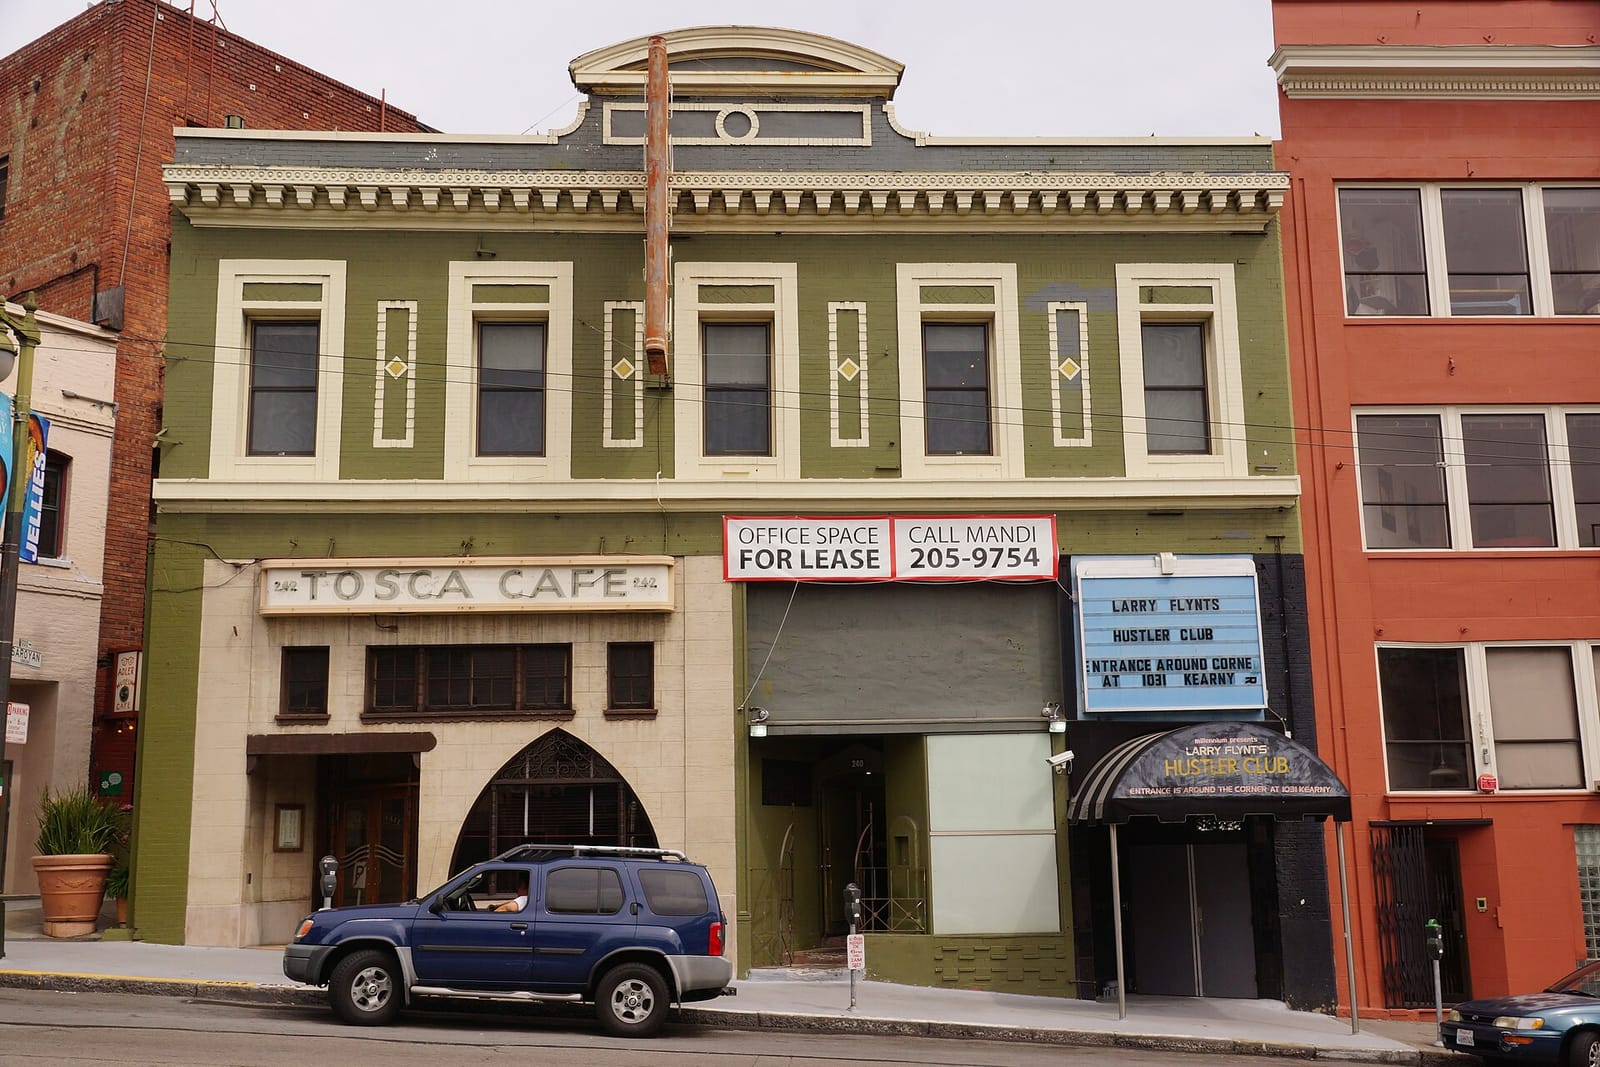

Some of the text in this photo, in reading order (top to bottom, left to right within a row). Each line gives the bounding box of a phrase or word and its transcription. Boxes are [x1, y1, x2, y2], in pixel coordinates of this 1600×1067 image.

[26, 450, 46, 561] JELLIES
[738, 526, 879, 545] OFFICE SPACE
[908, 525, 1037, 544] CALL MANDI
[739, 549, 880, 570] FOR LEASE
[910, 547, 1040, 569] 205-9754
[274, 568, 659, 601] 242 TOSCA CAFE 242
[1112, 598, 1220, 613] LARRY FLYNTS
[1113, 628, 1213, 642] HUSTLER CLUB
[1086, 657, 1252, 673] ENTRANCE AROUND CORNE
[1102, 675, 1120, 687] AT
[1142, 673, 1167, 687] 1031
[1184, 672, 1235, 686] KEARNY
[1185, 745, 1269, 756] LARRY FLYNT'S
[1165, 756, 1289, 776] HUSTLER CLUB
[1129, 787, 1171, 795] ENTRANCE
[1183, 786, 1216, 794] AROUND
[1217, 785, 1233, 793] THE
[1234, 785, 1267, 793] CORNER
[1270, 785, 1280, 793] AT
[1281, 785, 1298, 793] 1031
[1298, 785, 1331, 793] KEARNY
